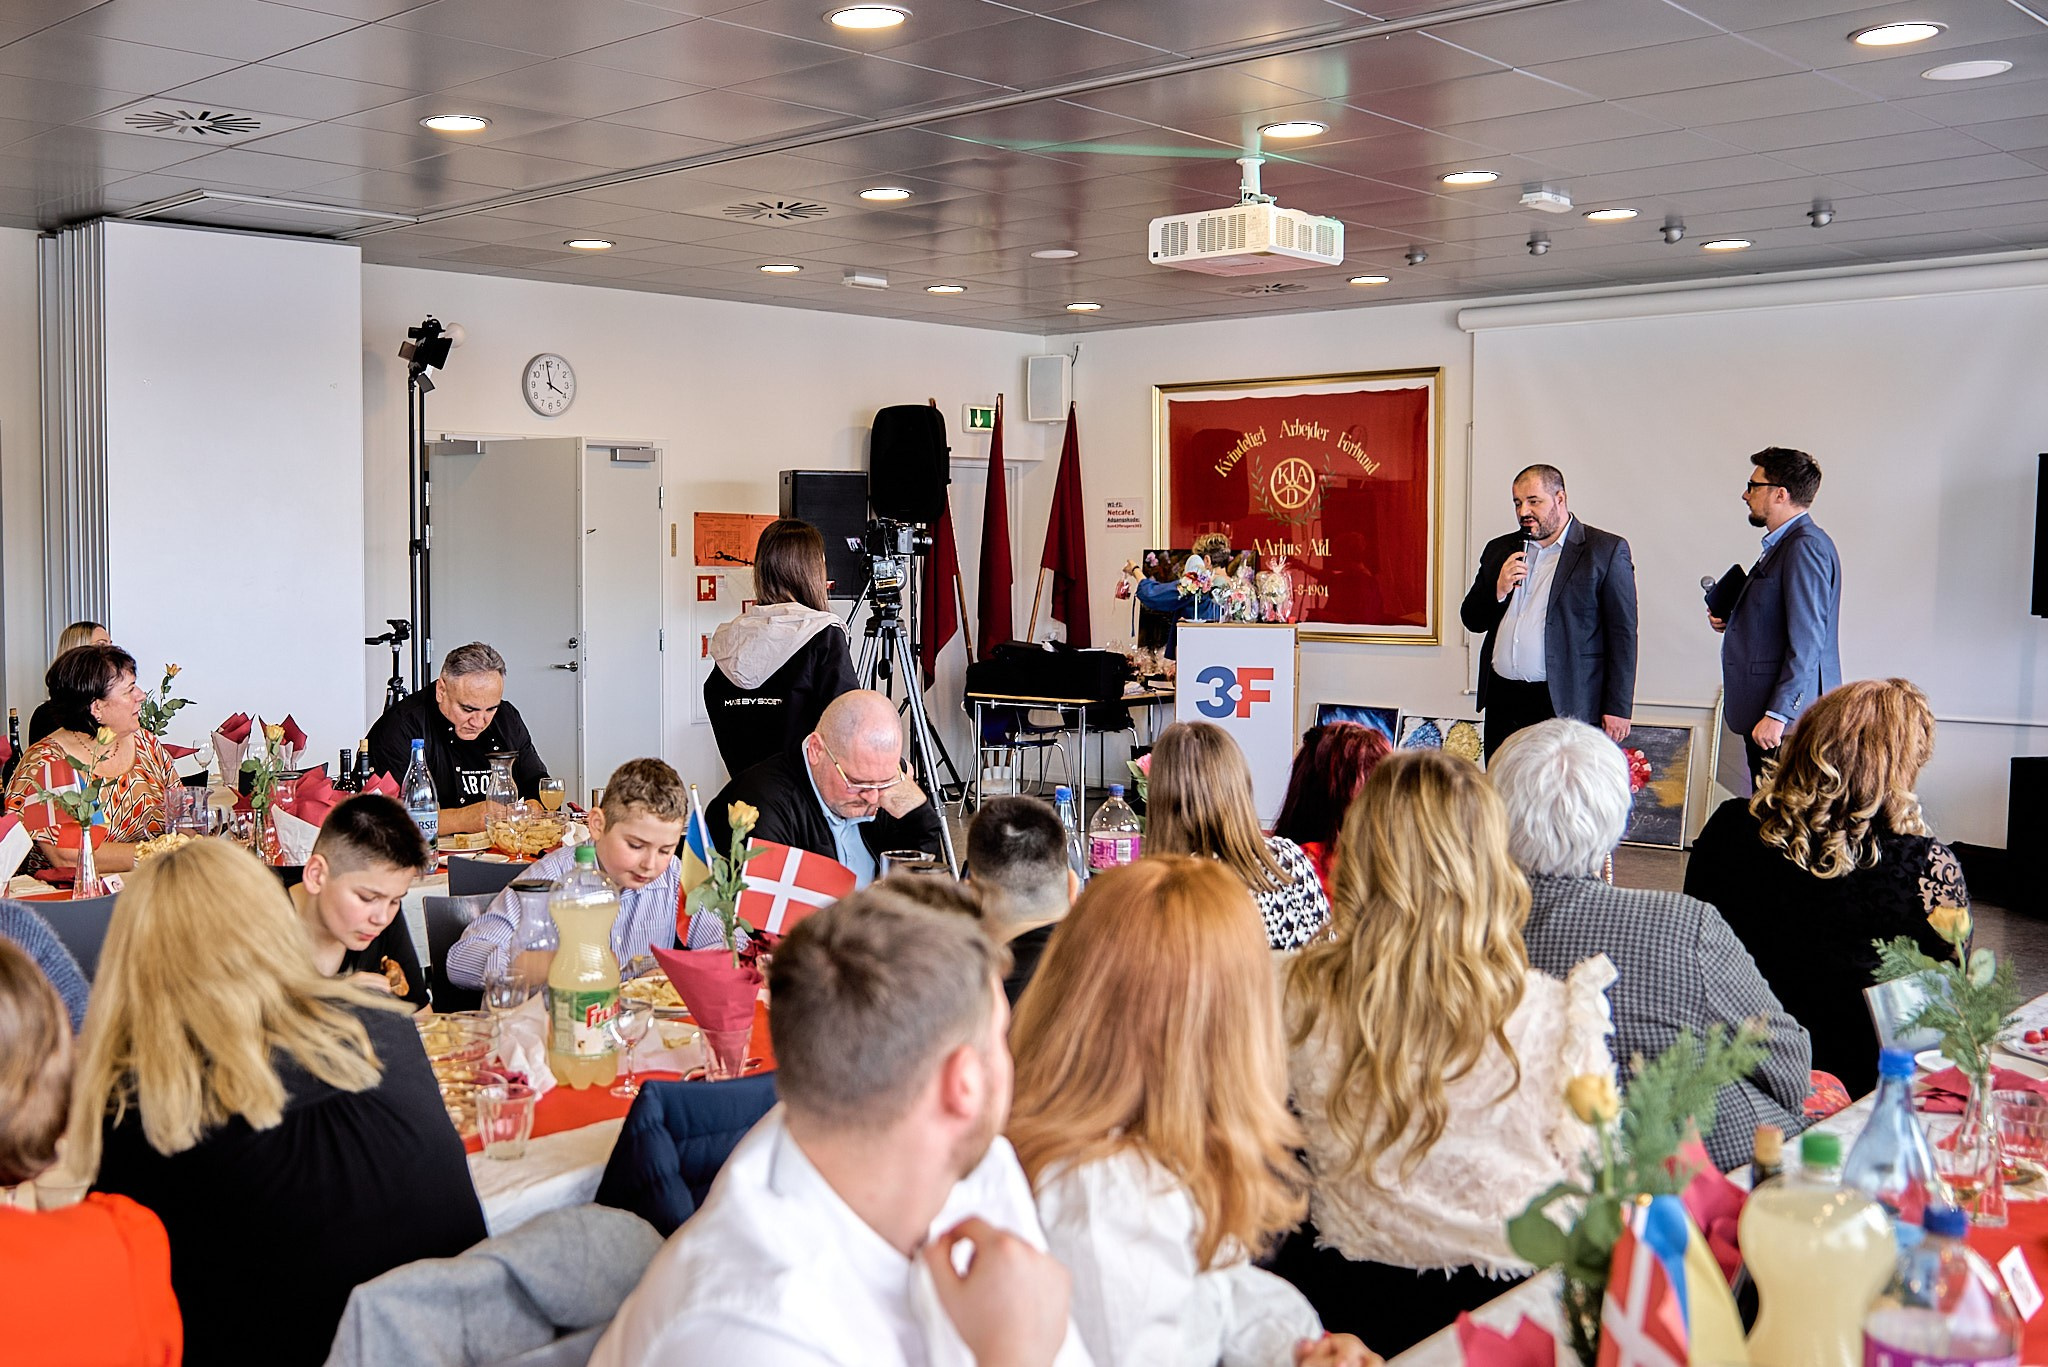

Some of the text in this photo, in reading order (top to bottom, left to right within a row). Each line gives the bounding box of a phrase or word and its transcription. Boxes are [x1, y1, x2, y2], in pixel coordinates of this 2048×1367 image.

[1214, 418, 1380, 477] Kvindeligt Arbejder Forbund
[1293, 584, 1329, 597] -8-1901
[1195, 665, 1274, 719] 3F
[417, 820, 437, 830] RSEC
